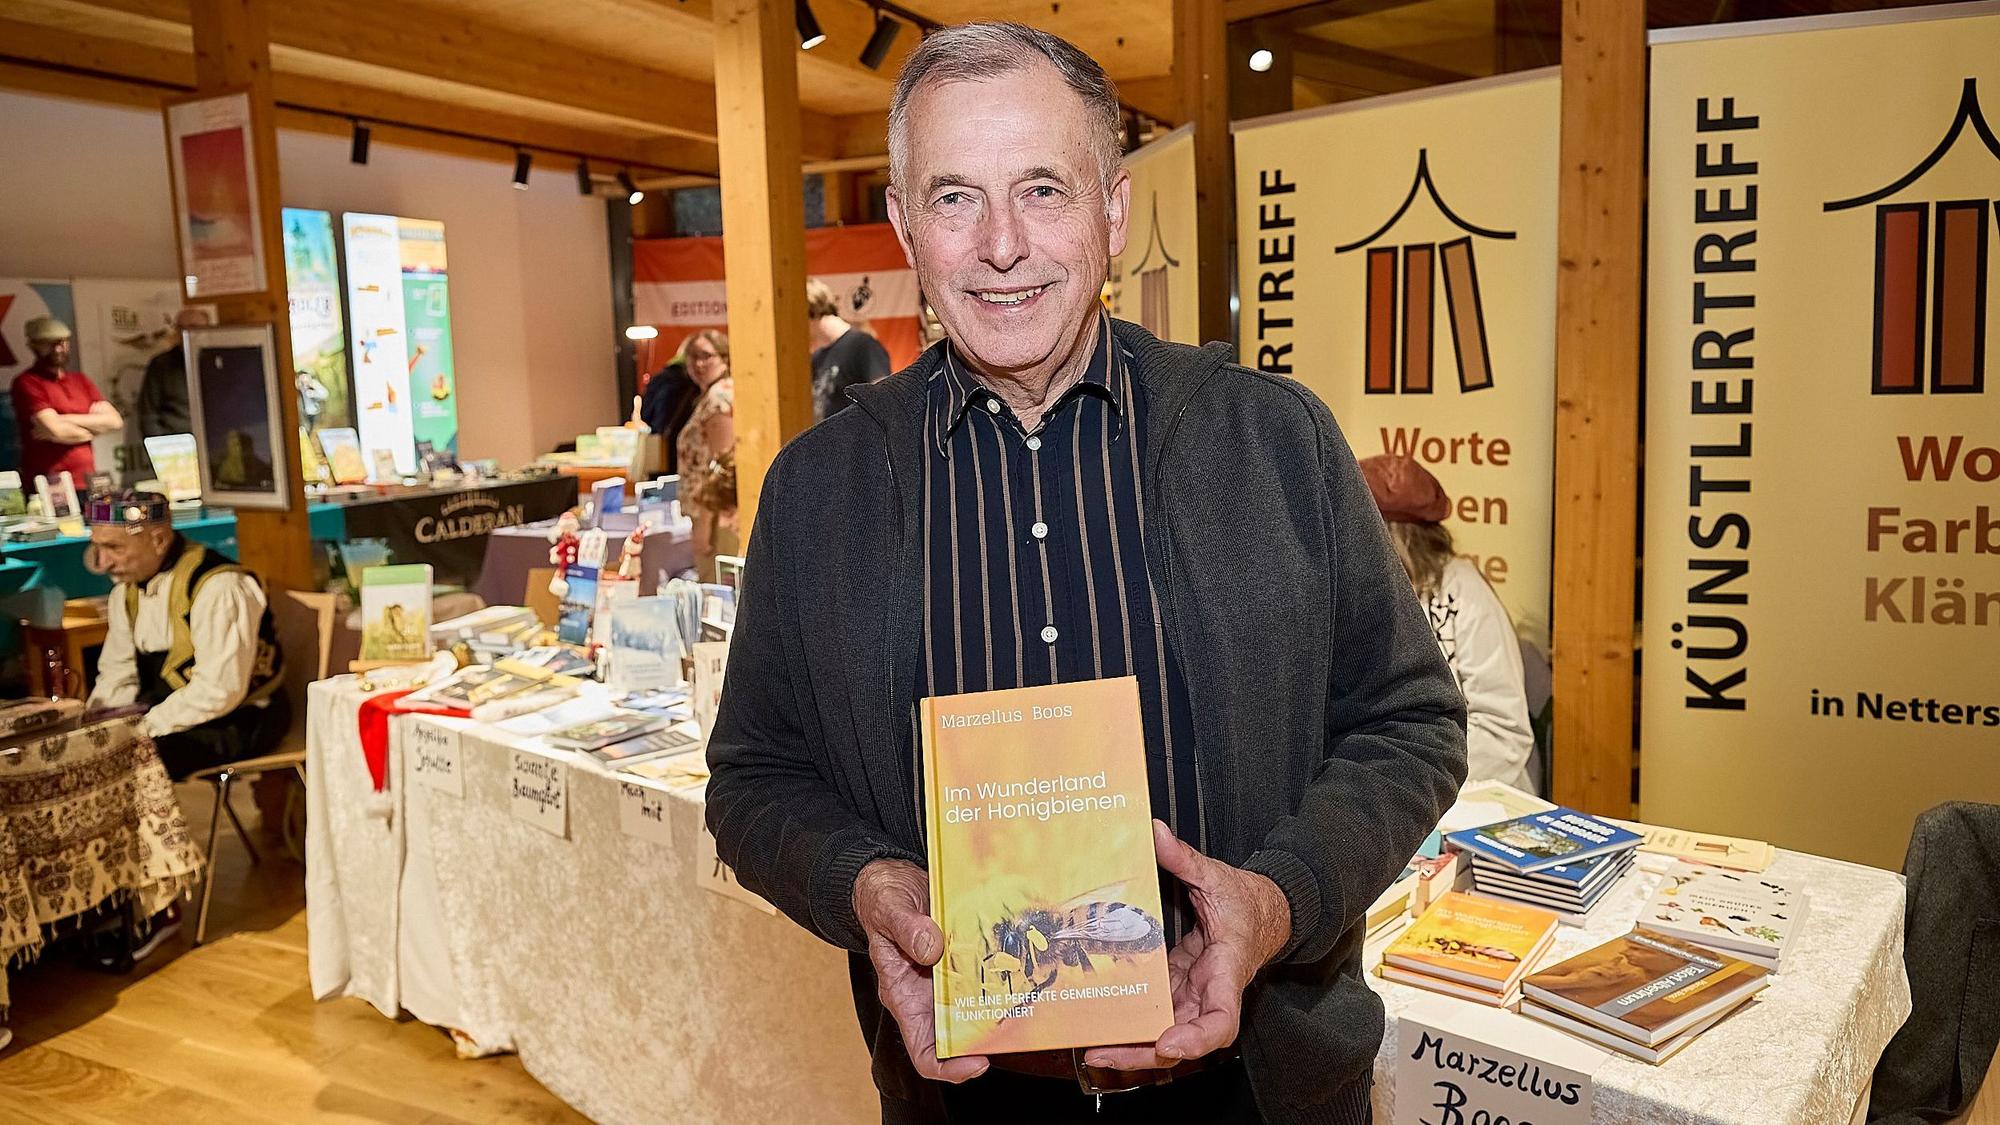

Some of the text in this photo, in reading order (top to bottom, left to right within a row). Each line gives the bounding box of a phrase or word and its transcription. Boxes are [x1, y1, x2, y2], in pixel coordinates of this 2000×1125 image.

[1258, 169, 1296, 374] RTREFF
[1671, 97, 1760, 711] KÜNSTLERTREFF
[1380, 427, 1511, 466] Worte
[941, 704, 1073, 729] Marzellus Boos
[1810, 688, 1845, 717] in
[944, 771, 1107, 803] Im Wunderland
[945, 792, 1127, 824] der Honigbienen
[954, 983, 1149, 1008] WIE EINE PERFEKTE GEMEINSCHAFT
[954, 1005, 1035, 1023] FUNKTIONIERT
[1411, 1031, 1582, 1105] Marzellus
